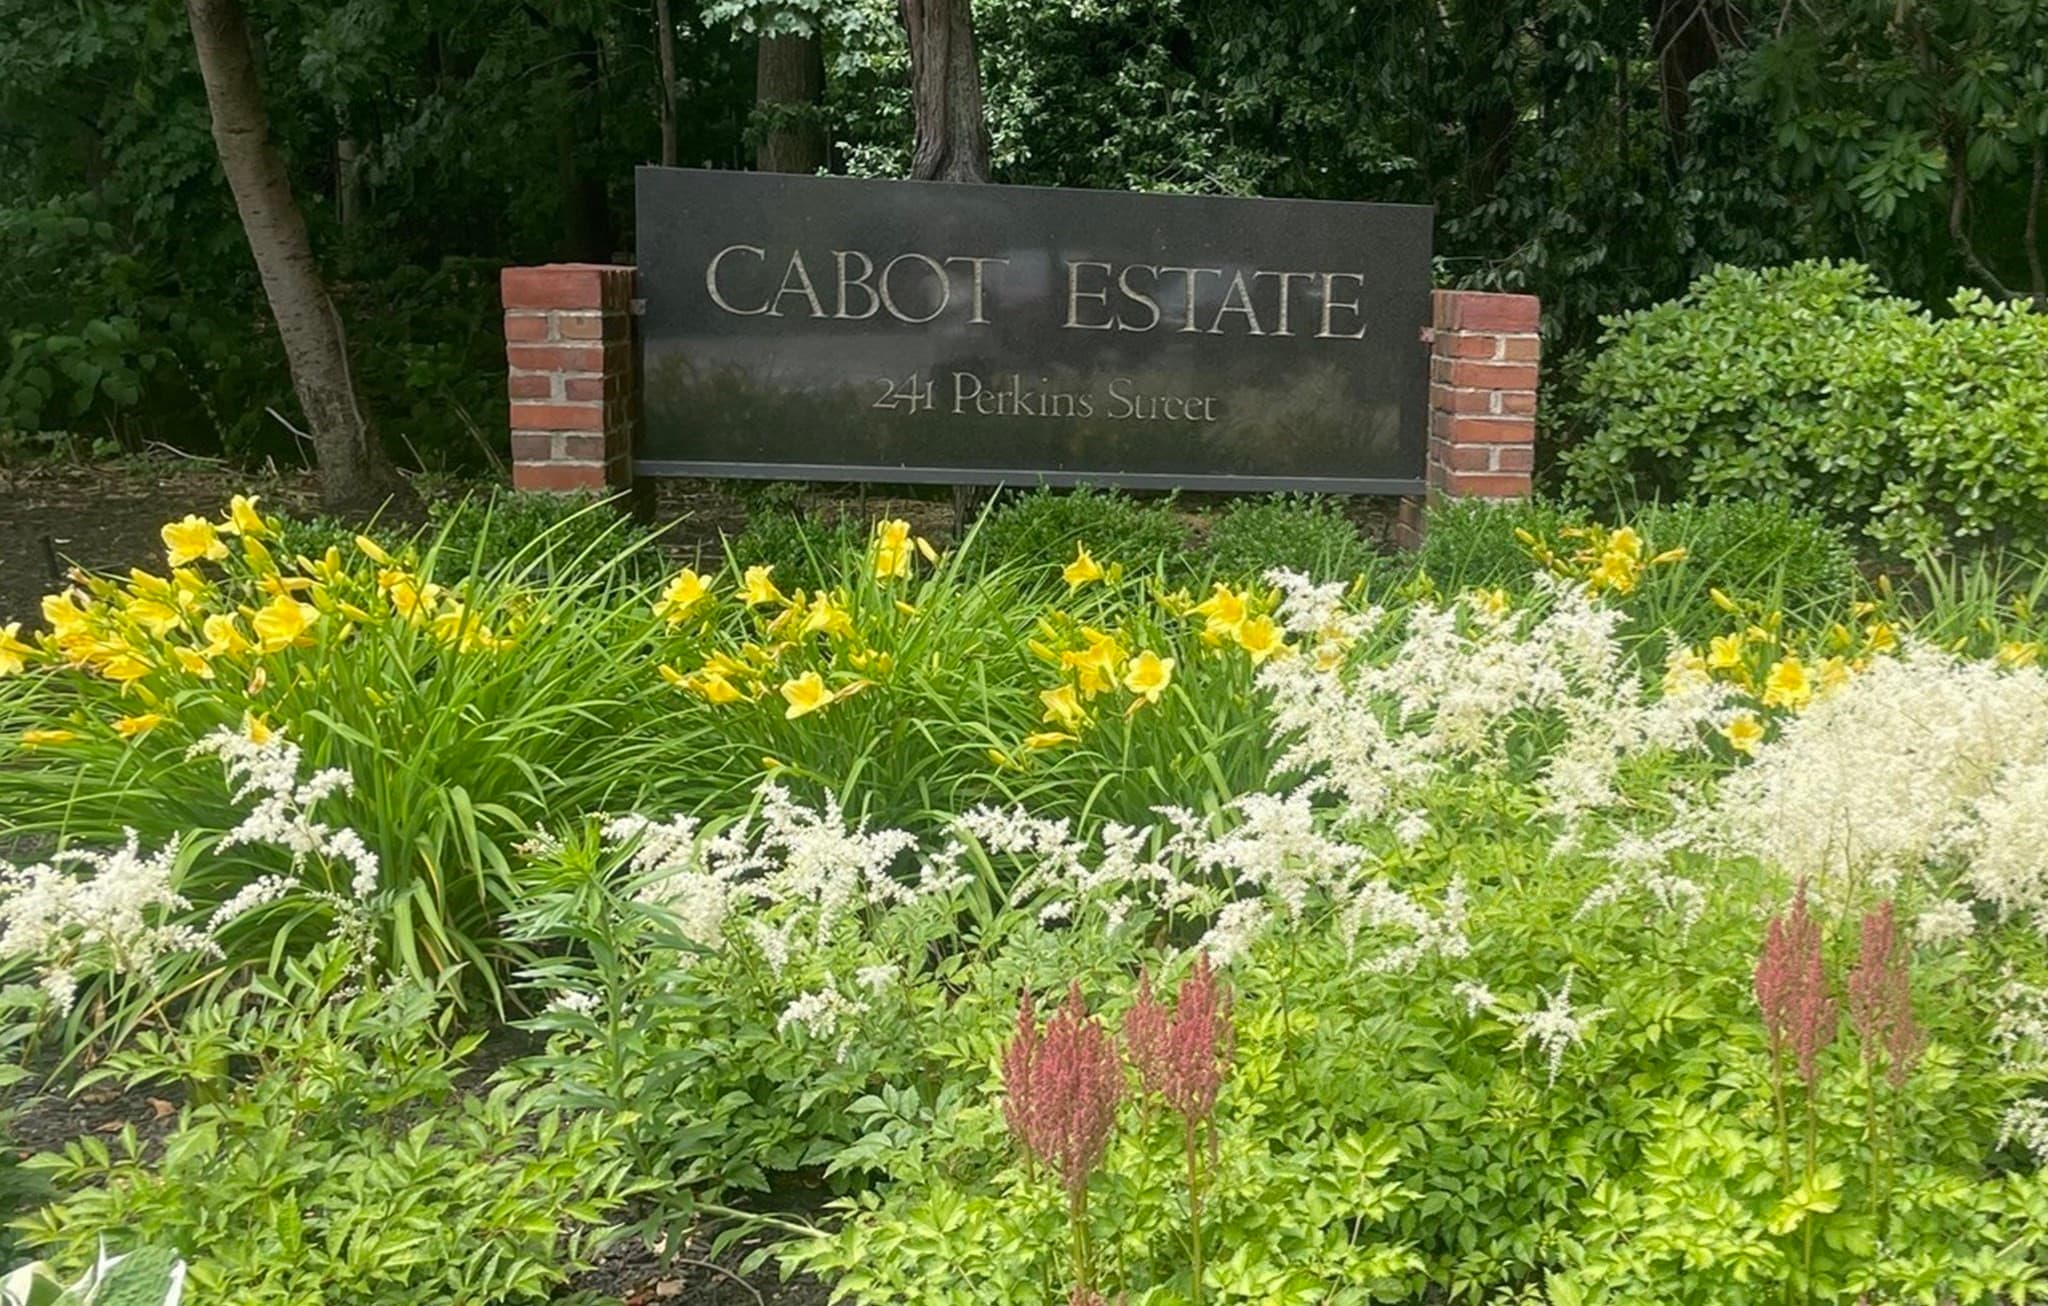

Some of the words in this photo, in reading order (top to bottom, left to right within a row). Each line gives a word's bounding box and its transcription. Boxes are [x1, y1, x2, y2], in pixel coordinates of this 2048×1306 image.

[705, 244, 1010, 325] CABOT
[1061, 259, 1368, 340] ESTATE
[872, 369, 937, 416] 241
[951, 371, 1095, 418] Perkins
[1107, 377, 1217, 422] Street
